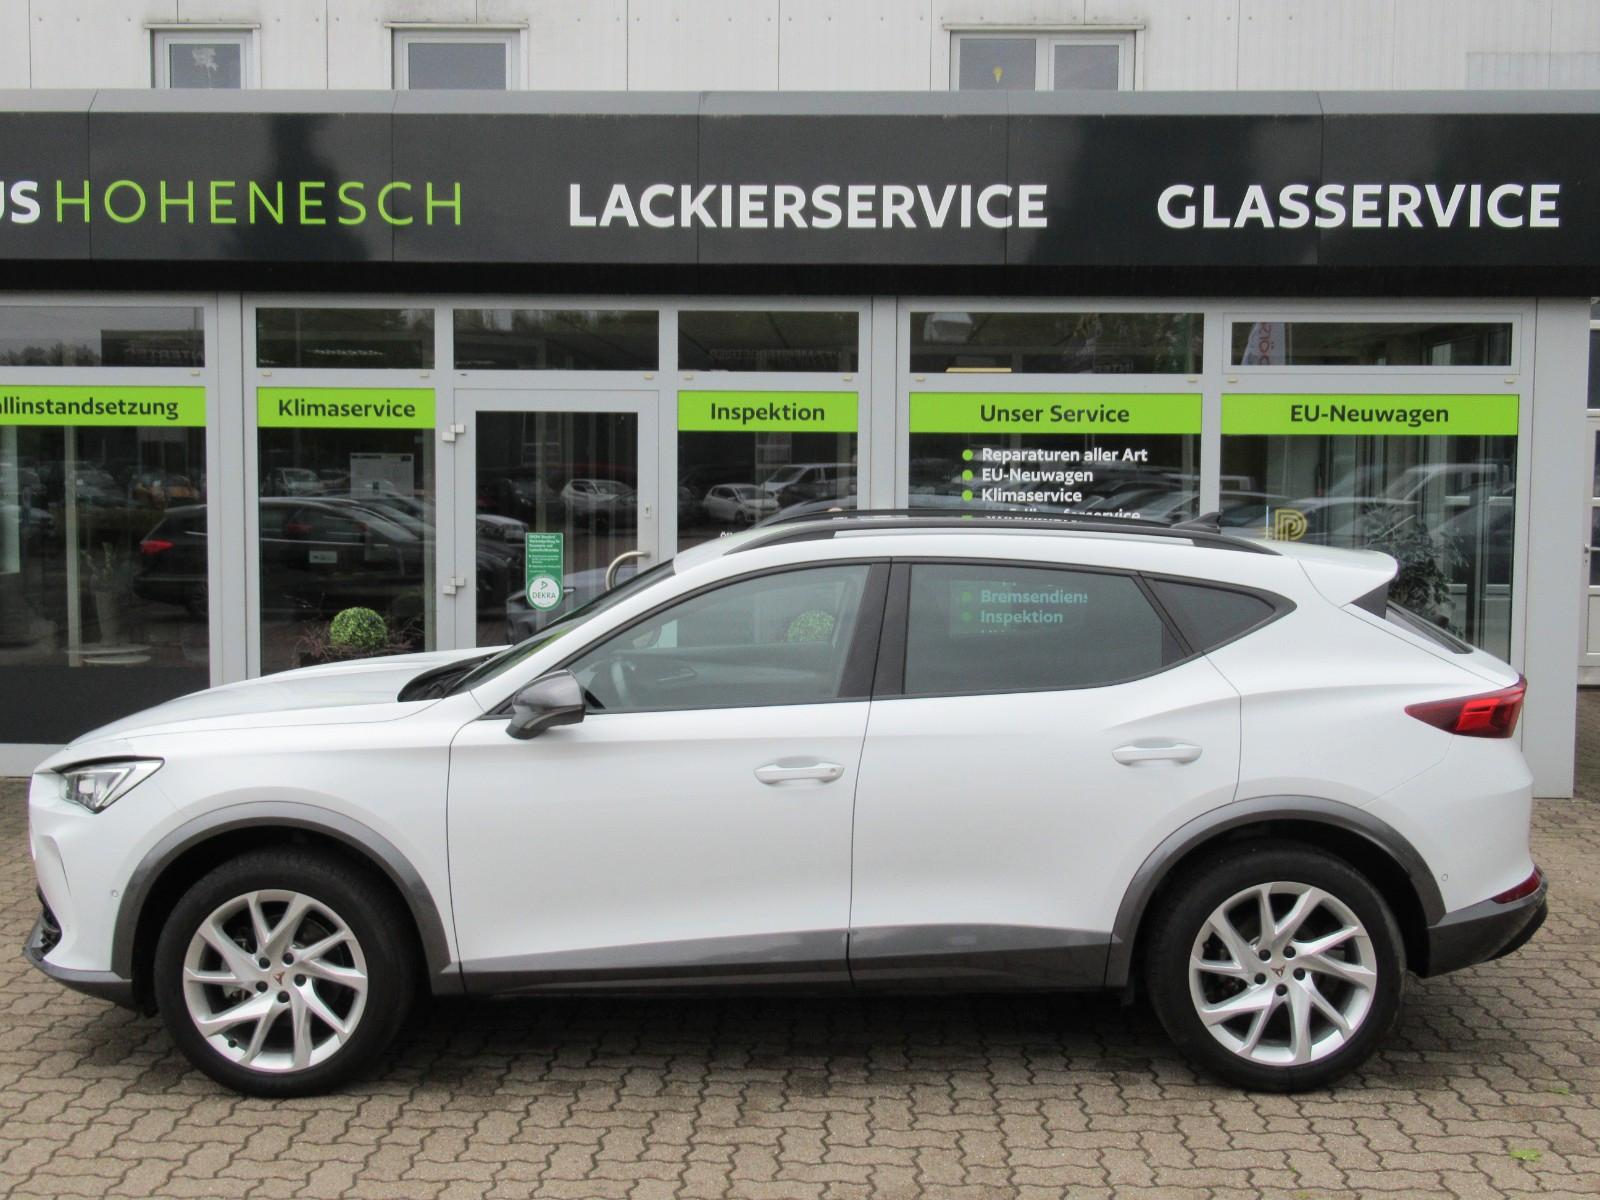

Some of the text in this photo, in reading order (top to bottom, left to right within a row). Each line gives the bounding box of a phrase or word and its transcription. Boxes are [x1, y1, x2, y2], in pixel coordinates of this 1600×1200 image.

[0, 179, 462, 226] S HOHENESCH
[569, 183, 1048, 229] LACKIERSERVICE
[1157, 183, 1561, 230] GLASSERVICE
[0, 396, 179, 421] llinstandsetzung
[279, 398, 416, 419] Klimaservice
[710, 402, 826, 424] Inspektion
[980, 404, 1130, 423] Unser Service
[1290, 404, 1450, 427] EU-Neuwagen
[982, 448, 1148, 465] Reparaturen aller Art
[982, 468, 1094, 485] EU-Neuwagen
[982, 488, 1082, 502] Klimaservice
[532, 591, 556, 599] DEKRA
[980, 610, 1063, 626] Inspektion
